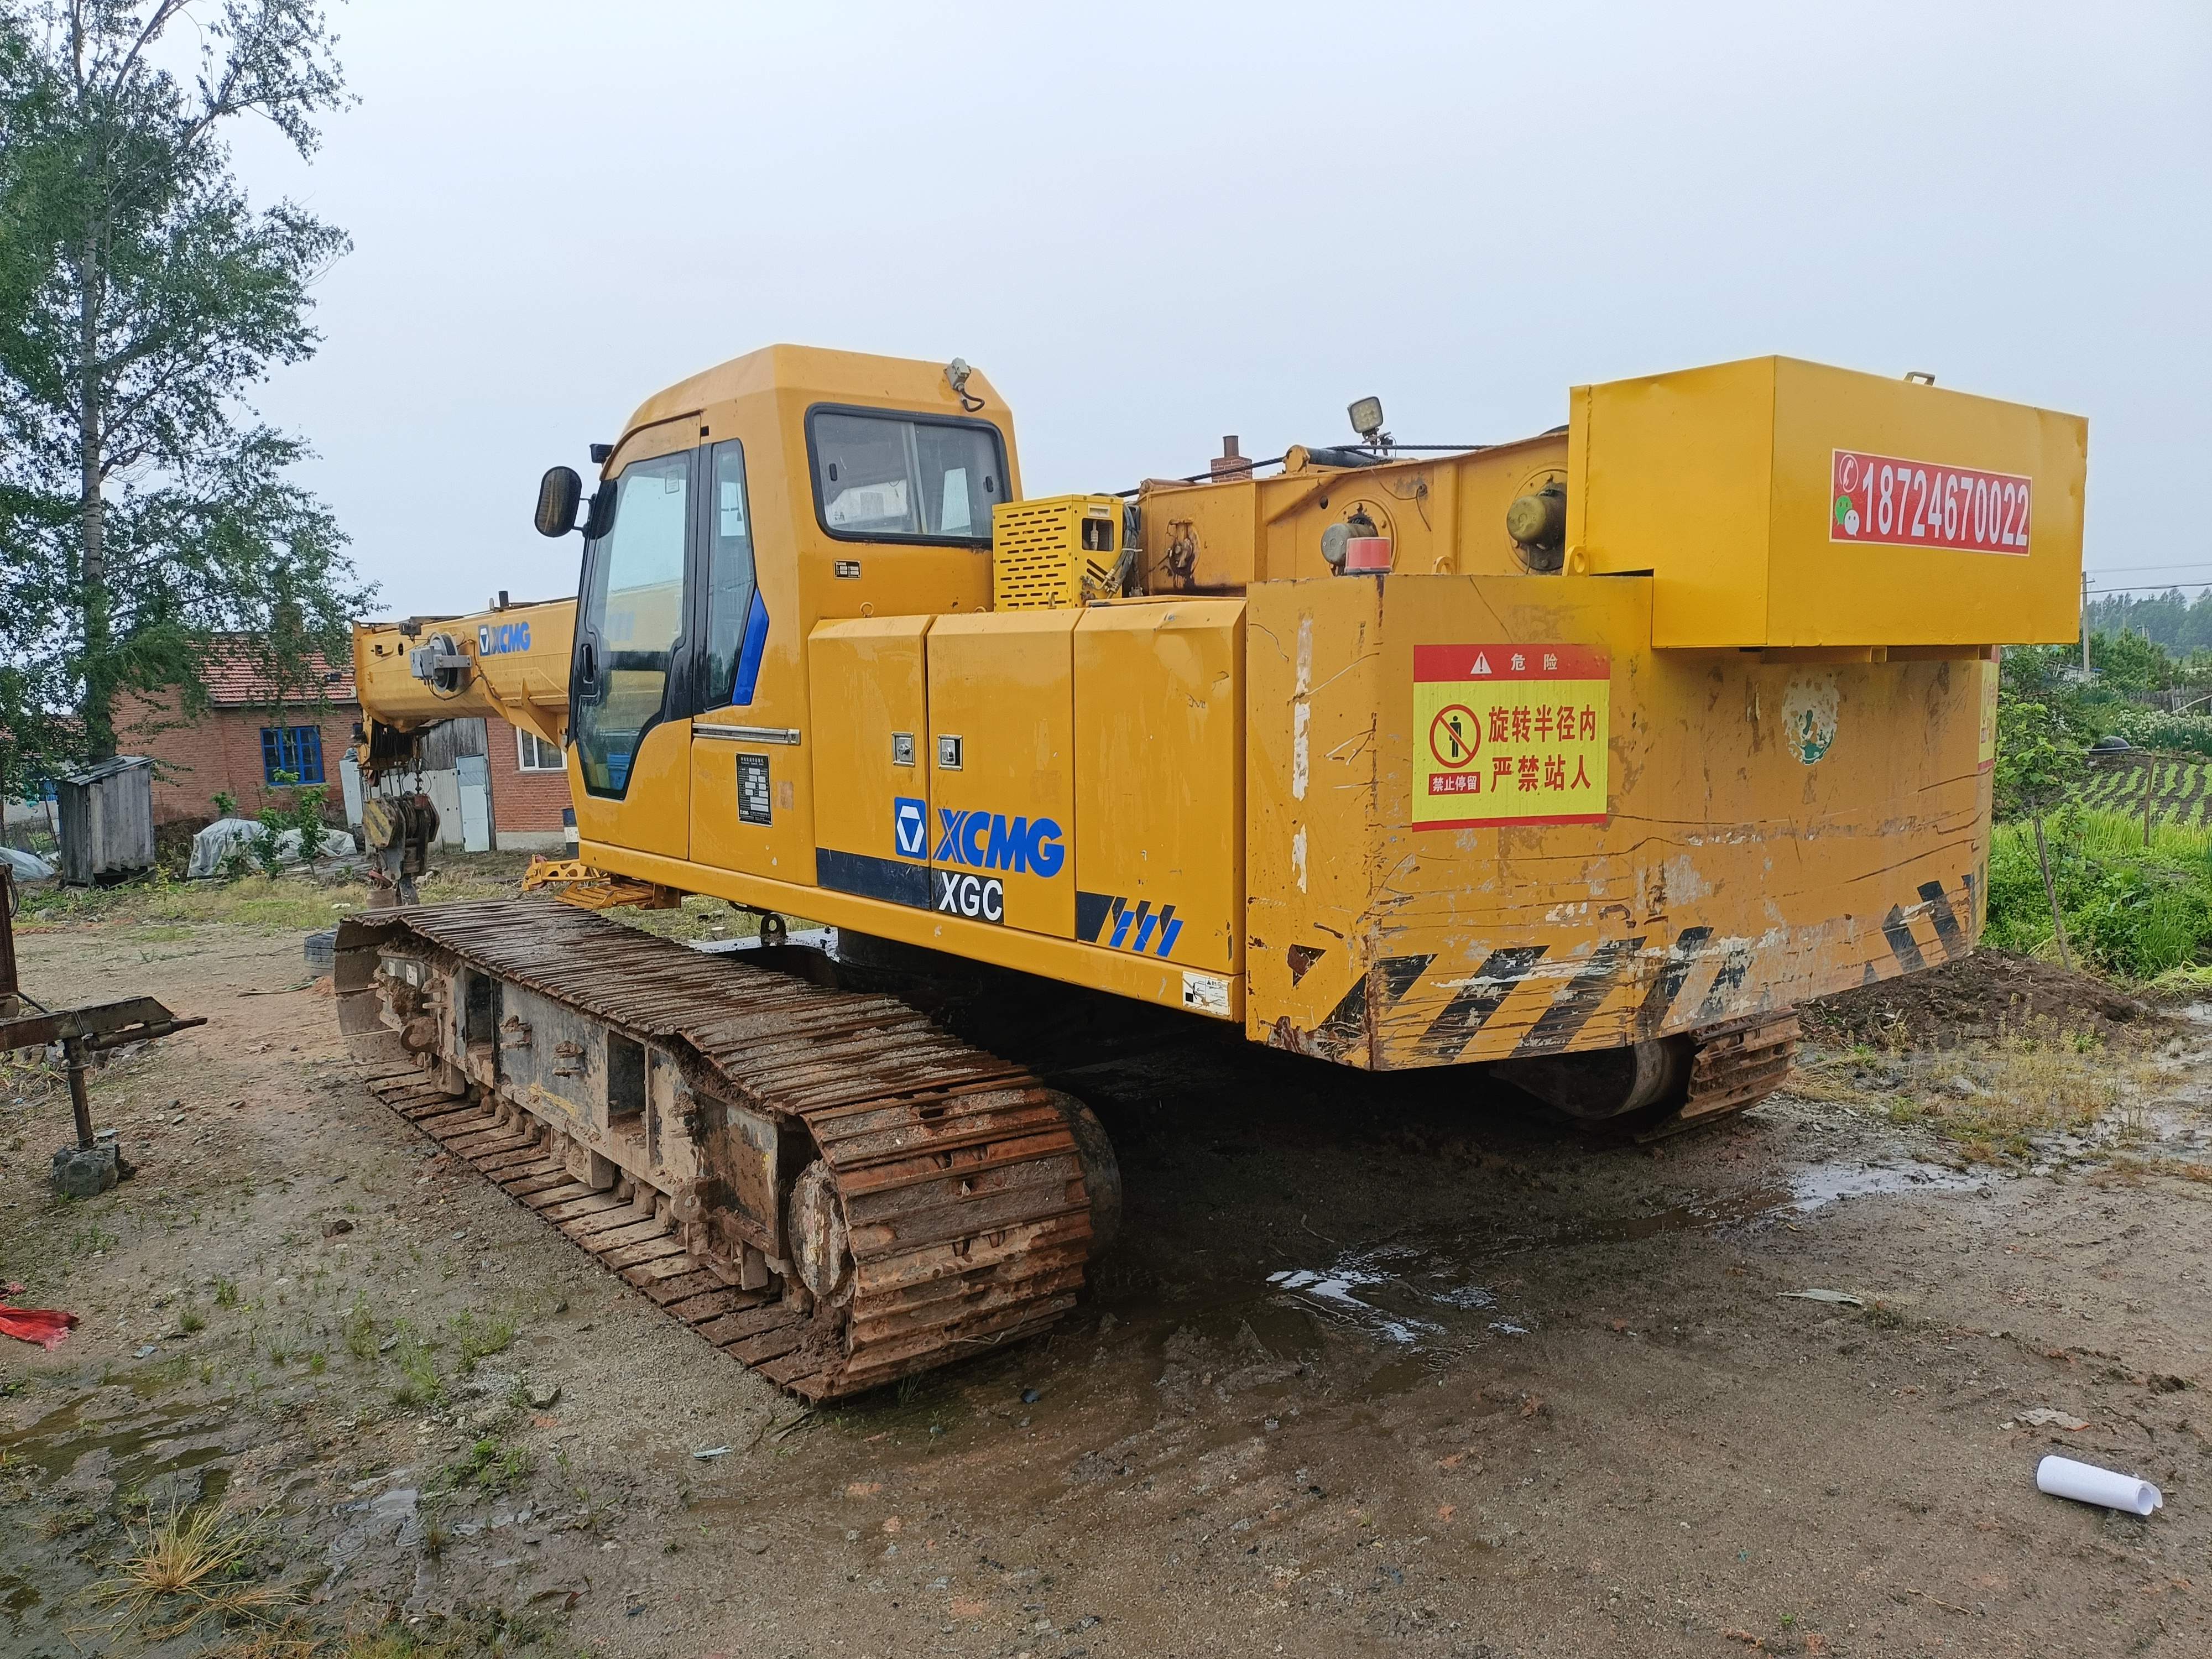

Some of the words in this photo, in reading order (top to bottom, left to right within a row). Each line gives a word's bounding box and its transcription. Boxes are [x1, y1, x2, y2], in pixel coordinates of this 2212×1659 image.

[1862, 462, 2028, 546] 18724670022
[491, 621, 531, 655] XCMG
[1511, 653, 1558, 671] 危险
[1488, 705, 1595, 743] 旋转半径内
[1432, 775, 1477, 792] 禁止停留
[1490, 754, 1591, 792] 严禁站人
[932, 808, 1065, 878] XCMG
[938, 871, 1003, 921] XGC
